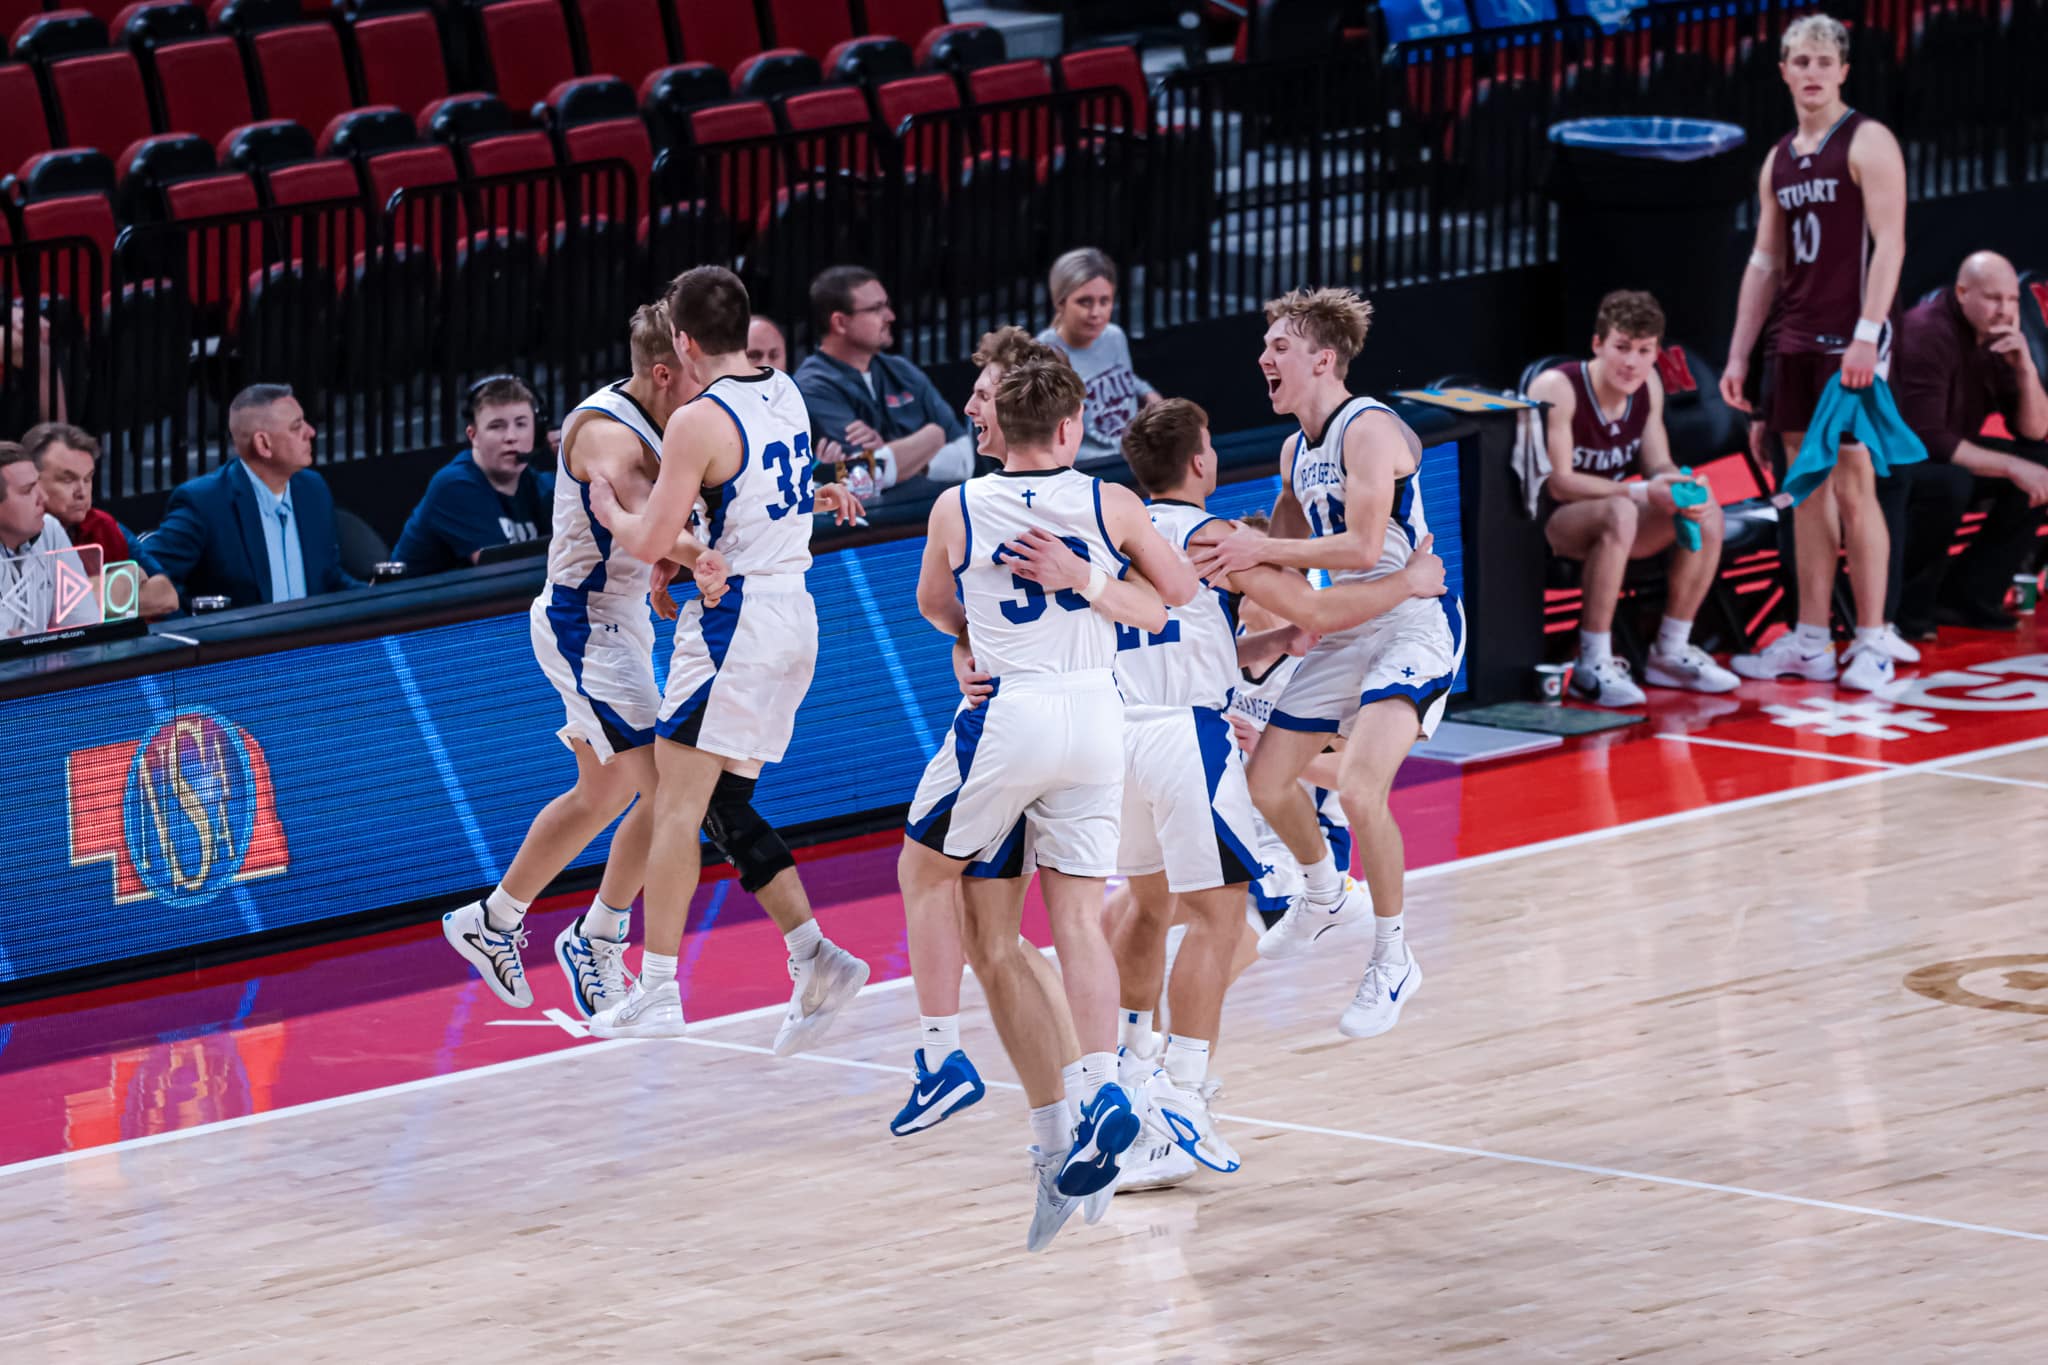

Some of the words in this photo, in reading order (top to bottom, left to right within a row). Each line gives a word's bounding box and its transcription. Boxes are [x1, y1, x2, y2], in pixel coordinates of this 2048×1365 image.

[1777, 178, 1839, 210] STUART
[1792, 211, 1821, 265] 10
[762, 431, 815, 521] 32
